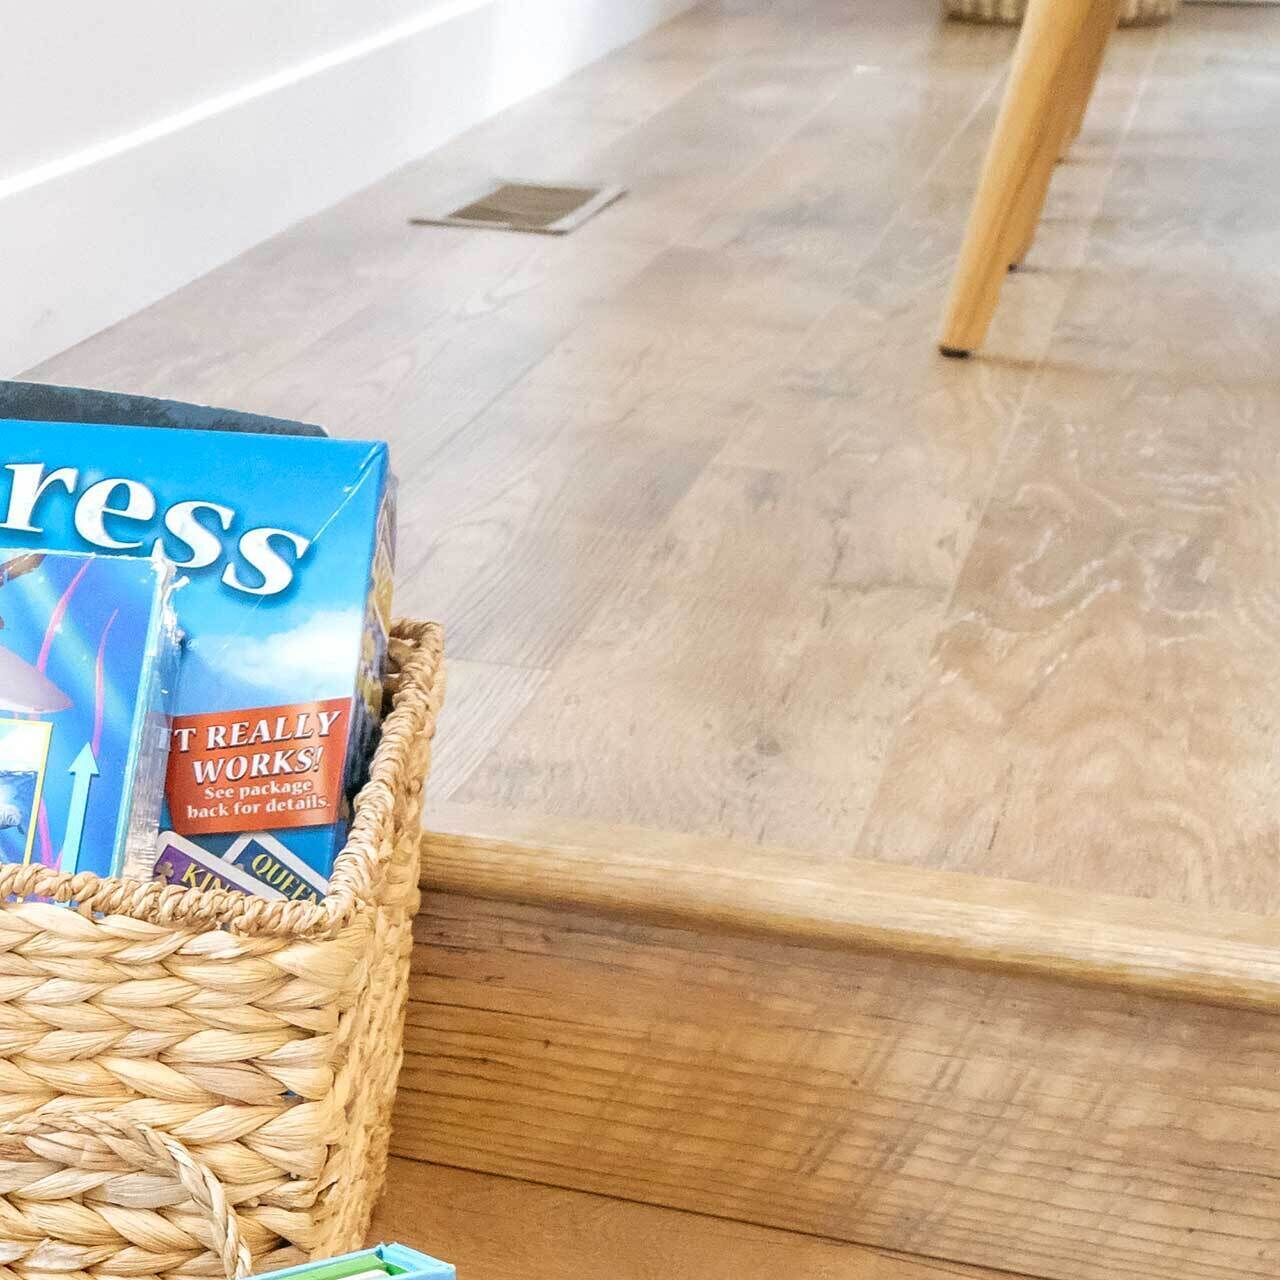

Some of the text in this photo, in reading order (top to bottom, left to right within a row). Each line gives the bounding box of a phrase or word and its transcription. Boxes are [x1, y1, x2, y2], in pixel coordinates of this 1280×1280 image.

[205, 710, 342, 751] REALLY
[191, 746, 325, 785] WORKS!
[204, 779, 313, 801] See package
[187, 794, 332, 819] back for details.
